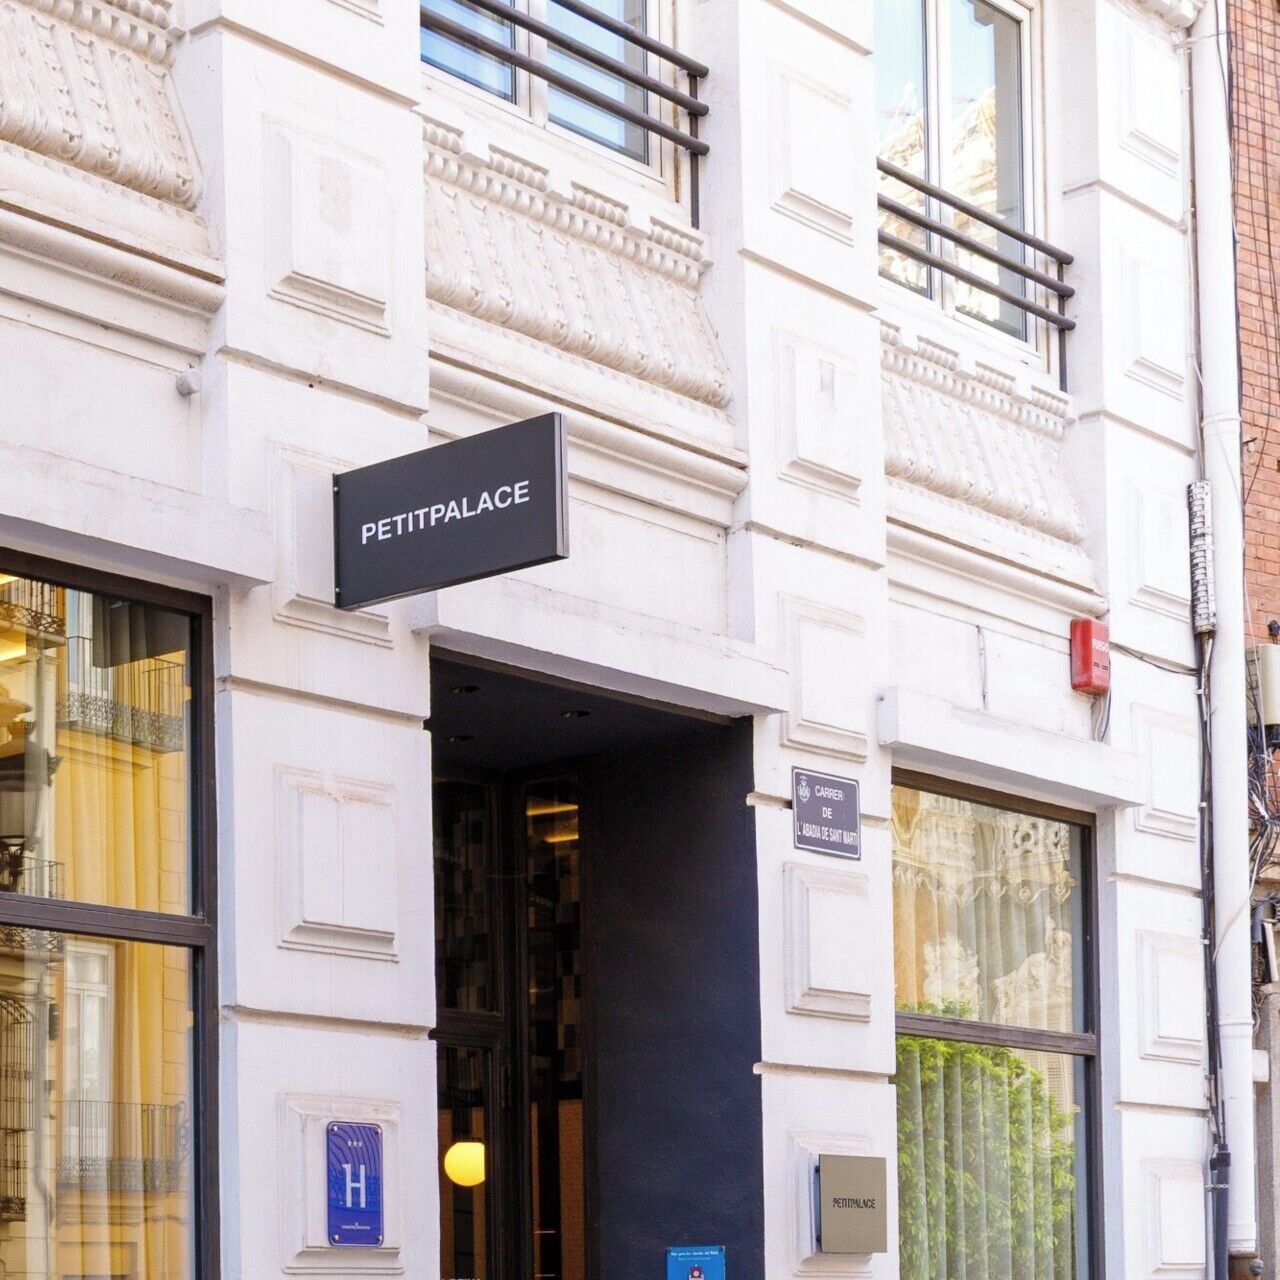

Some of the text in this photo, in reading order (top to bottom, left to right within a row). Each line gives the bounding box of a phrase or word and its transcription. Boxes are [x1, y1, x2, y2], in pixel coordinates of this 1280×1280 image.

[362, 480, 530, 545] PETITPALACE
[814, 785, 844, 801] CARRER
[822, 806, 833, 819] DE
[822, 826, 829, 841] DE
[829, 828, 842, 843] SANT
[342, 1163, 366, 1208] H
[832, 1197, 876, 1209] PETITPALACE
